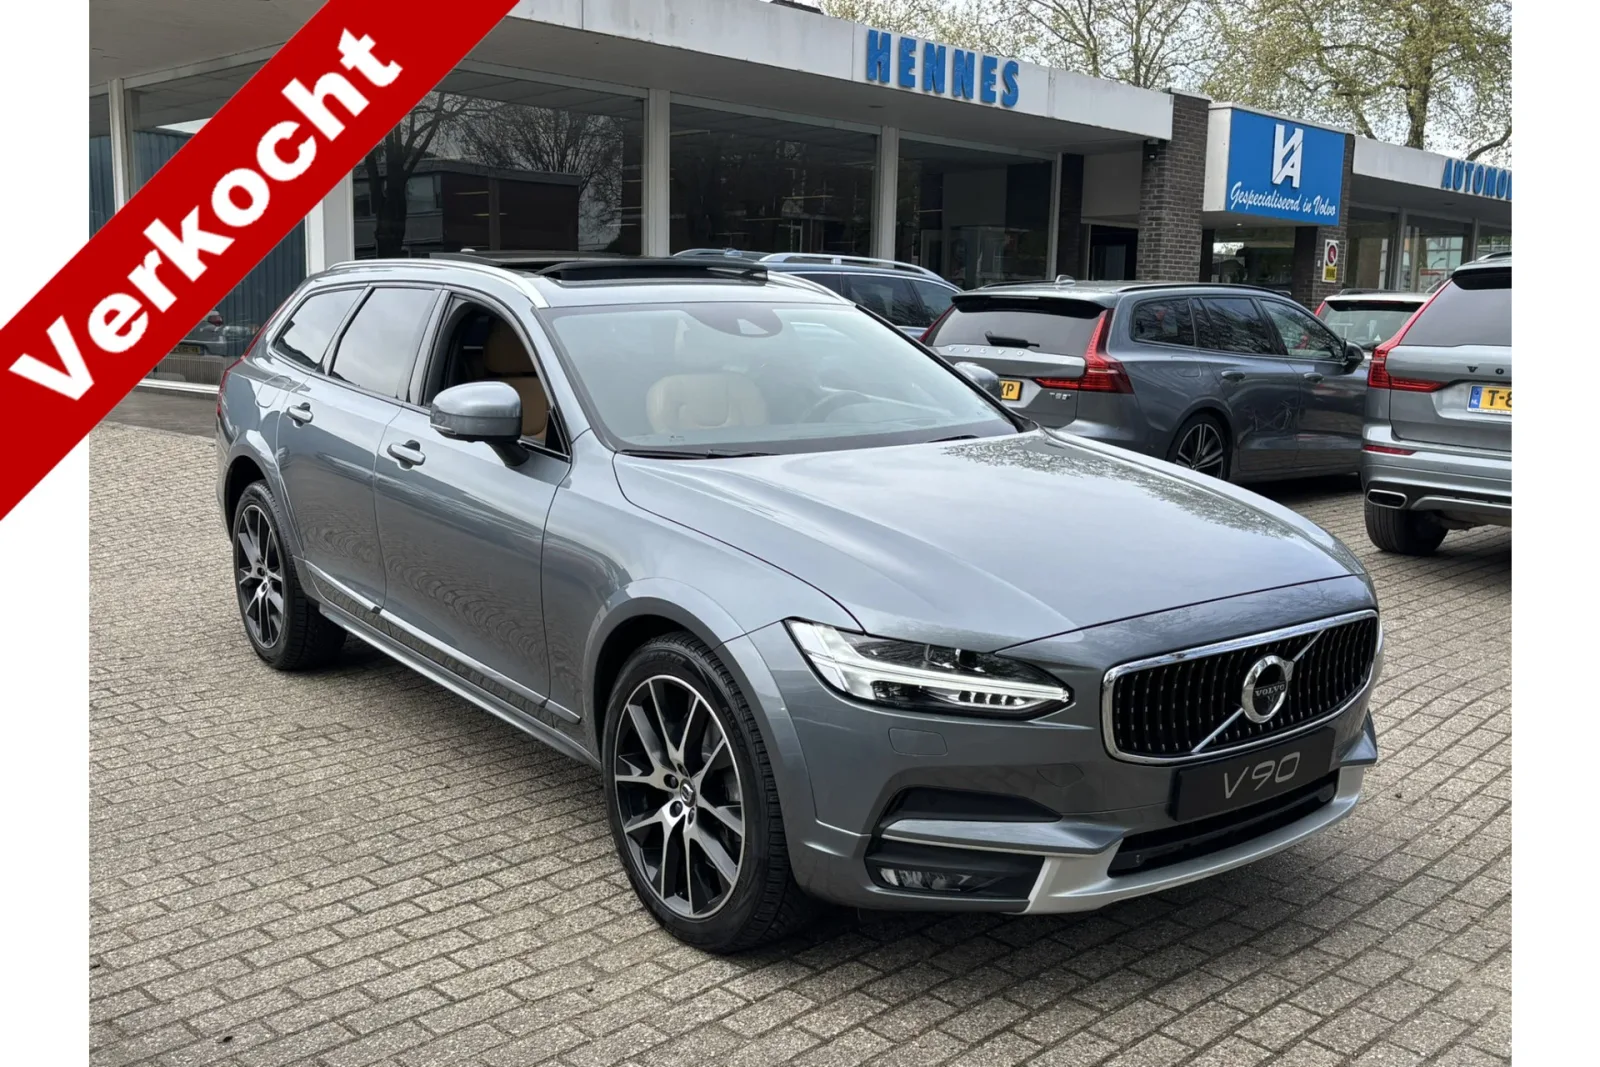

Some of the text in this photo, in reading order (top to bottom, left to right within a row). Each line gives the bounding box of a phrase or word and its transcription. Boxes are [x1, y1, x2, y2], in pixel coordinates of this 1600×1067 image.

[866, 29, 1020, 108] HENNES
[1230, 181, 1336, 217] Gespecialiseerd in Volvo
[948, 346, 1024, 357] VOLVO
[1255, 684, 1286, 697] VOLVO
[1223, 751, 1301, 800] V90
